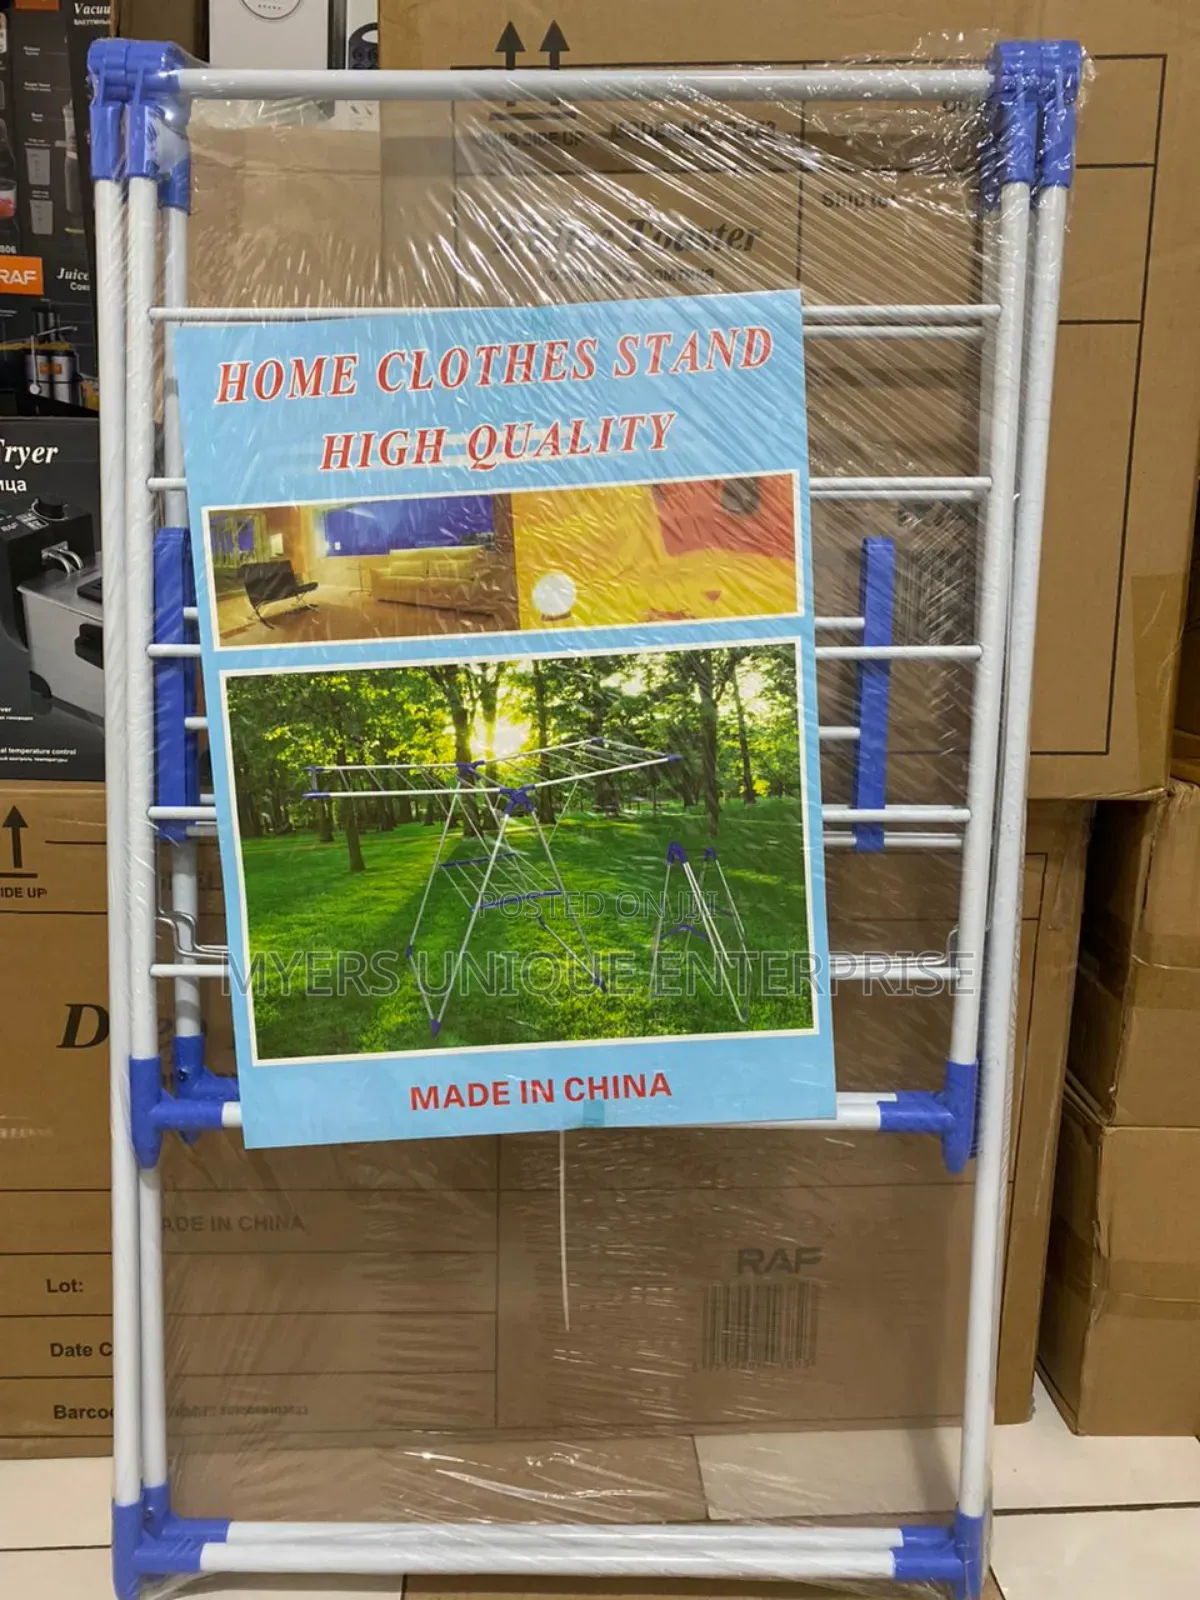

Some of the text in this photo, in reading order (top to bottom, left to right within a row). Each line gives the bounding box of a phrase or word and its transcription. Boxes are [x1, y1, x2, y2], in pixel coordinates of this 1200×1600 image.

[214, 325, 774, 404] HOME CLOTHES STAND
[319, 412, 676, 472] HIGH QUALITY
[27, 886, 48, 899] UP
[410, 1072, 673, 1111] MADE IN CHINA
[210, 1215, 232, 1232] IN
[238, 1214, 306, 1233] CHINA
[737, 1246, 823, 1275] RAF
[46, 1278, 84, 1293] Lot:
[50, 1342, 93, 1357] Date
